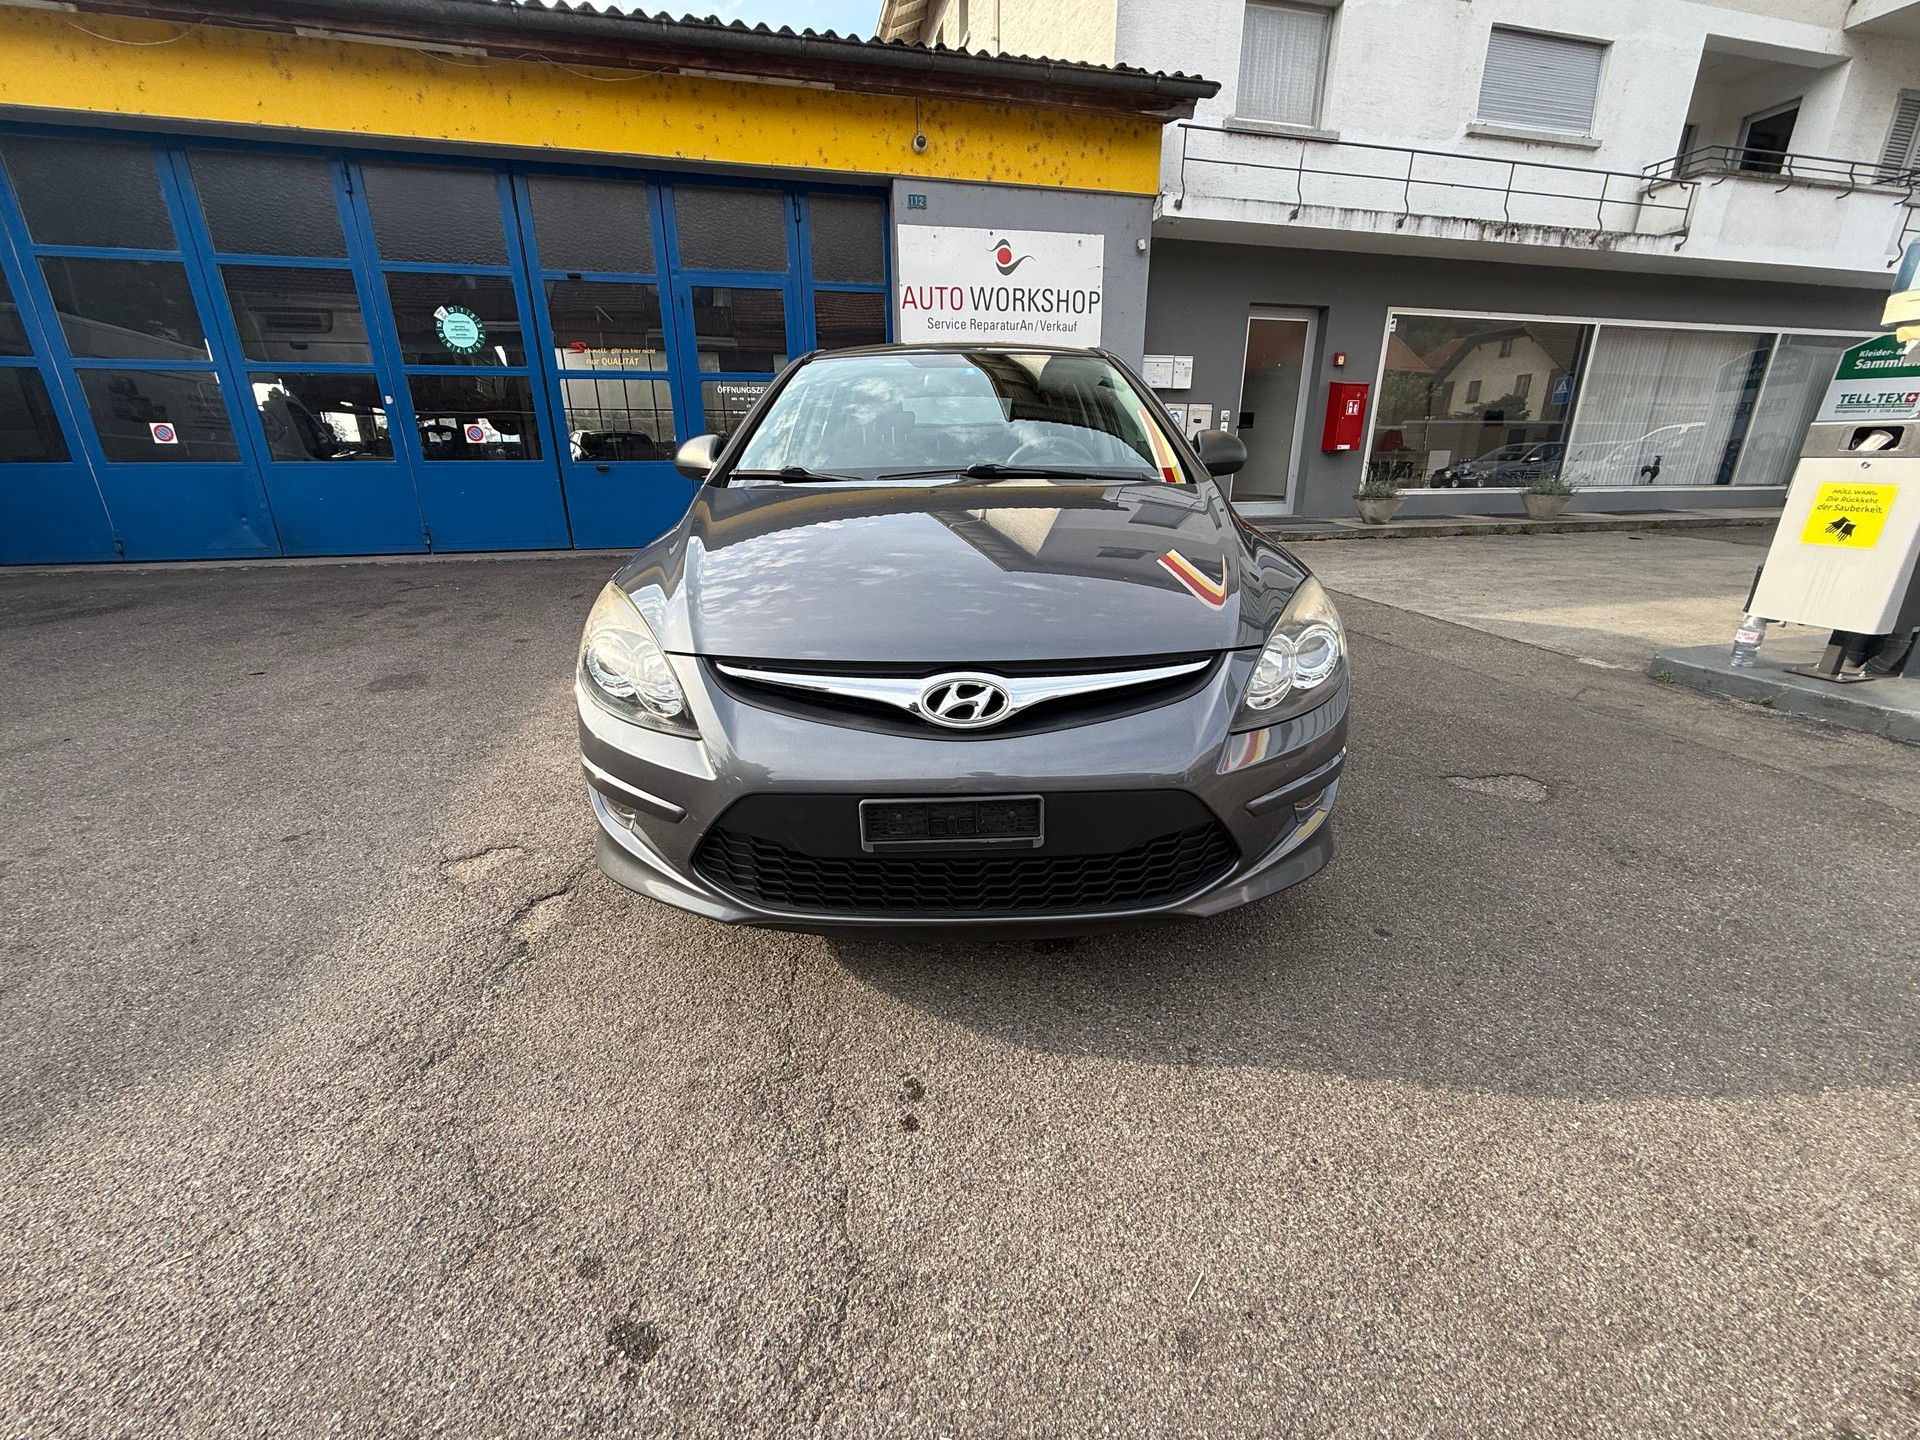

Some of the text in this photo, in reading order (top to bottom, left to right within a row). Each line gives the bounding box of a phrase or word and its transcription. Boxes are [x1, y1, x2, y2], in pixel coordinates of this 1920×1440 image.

[909, 196, 925, 207] 112
[901, 286, 1101, 315] AUTO WORKSHOP
[927, 317, 1078, 333] Service ReparaturAn/Verkauf
[1858, 349, 1894, 358] Kleider-
[601, 356, 640, 367] QUALITÄT
[1853, 355, 1920, 370] Samml
[1840, 392, 1906, 404] TELL-TEX
[1840, 496, 1879, 504] Rückkehr
[1816, 502, 1883, 514] der Sauberkeit
